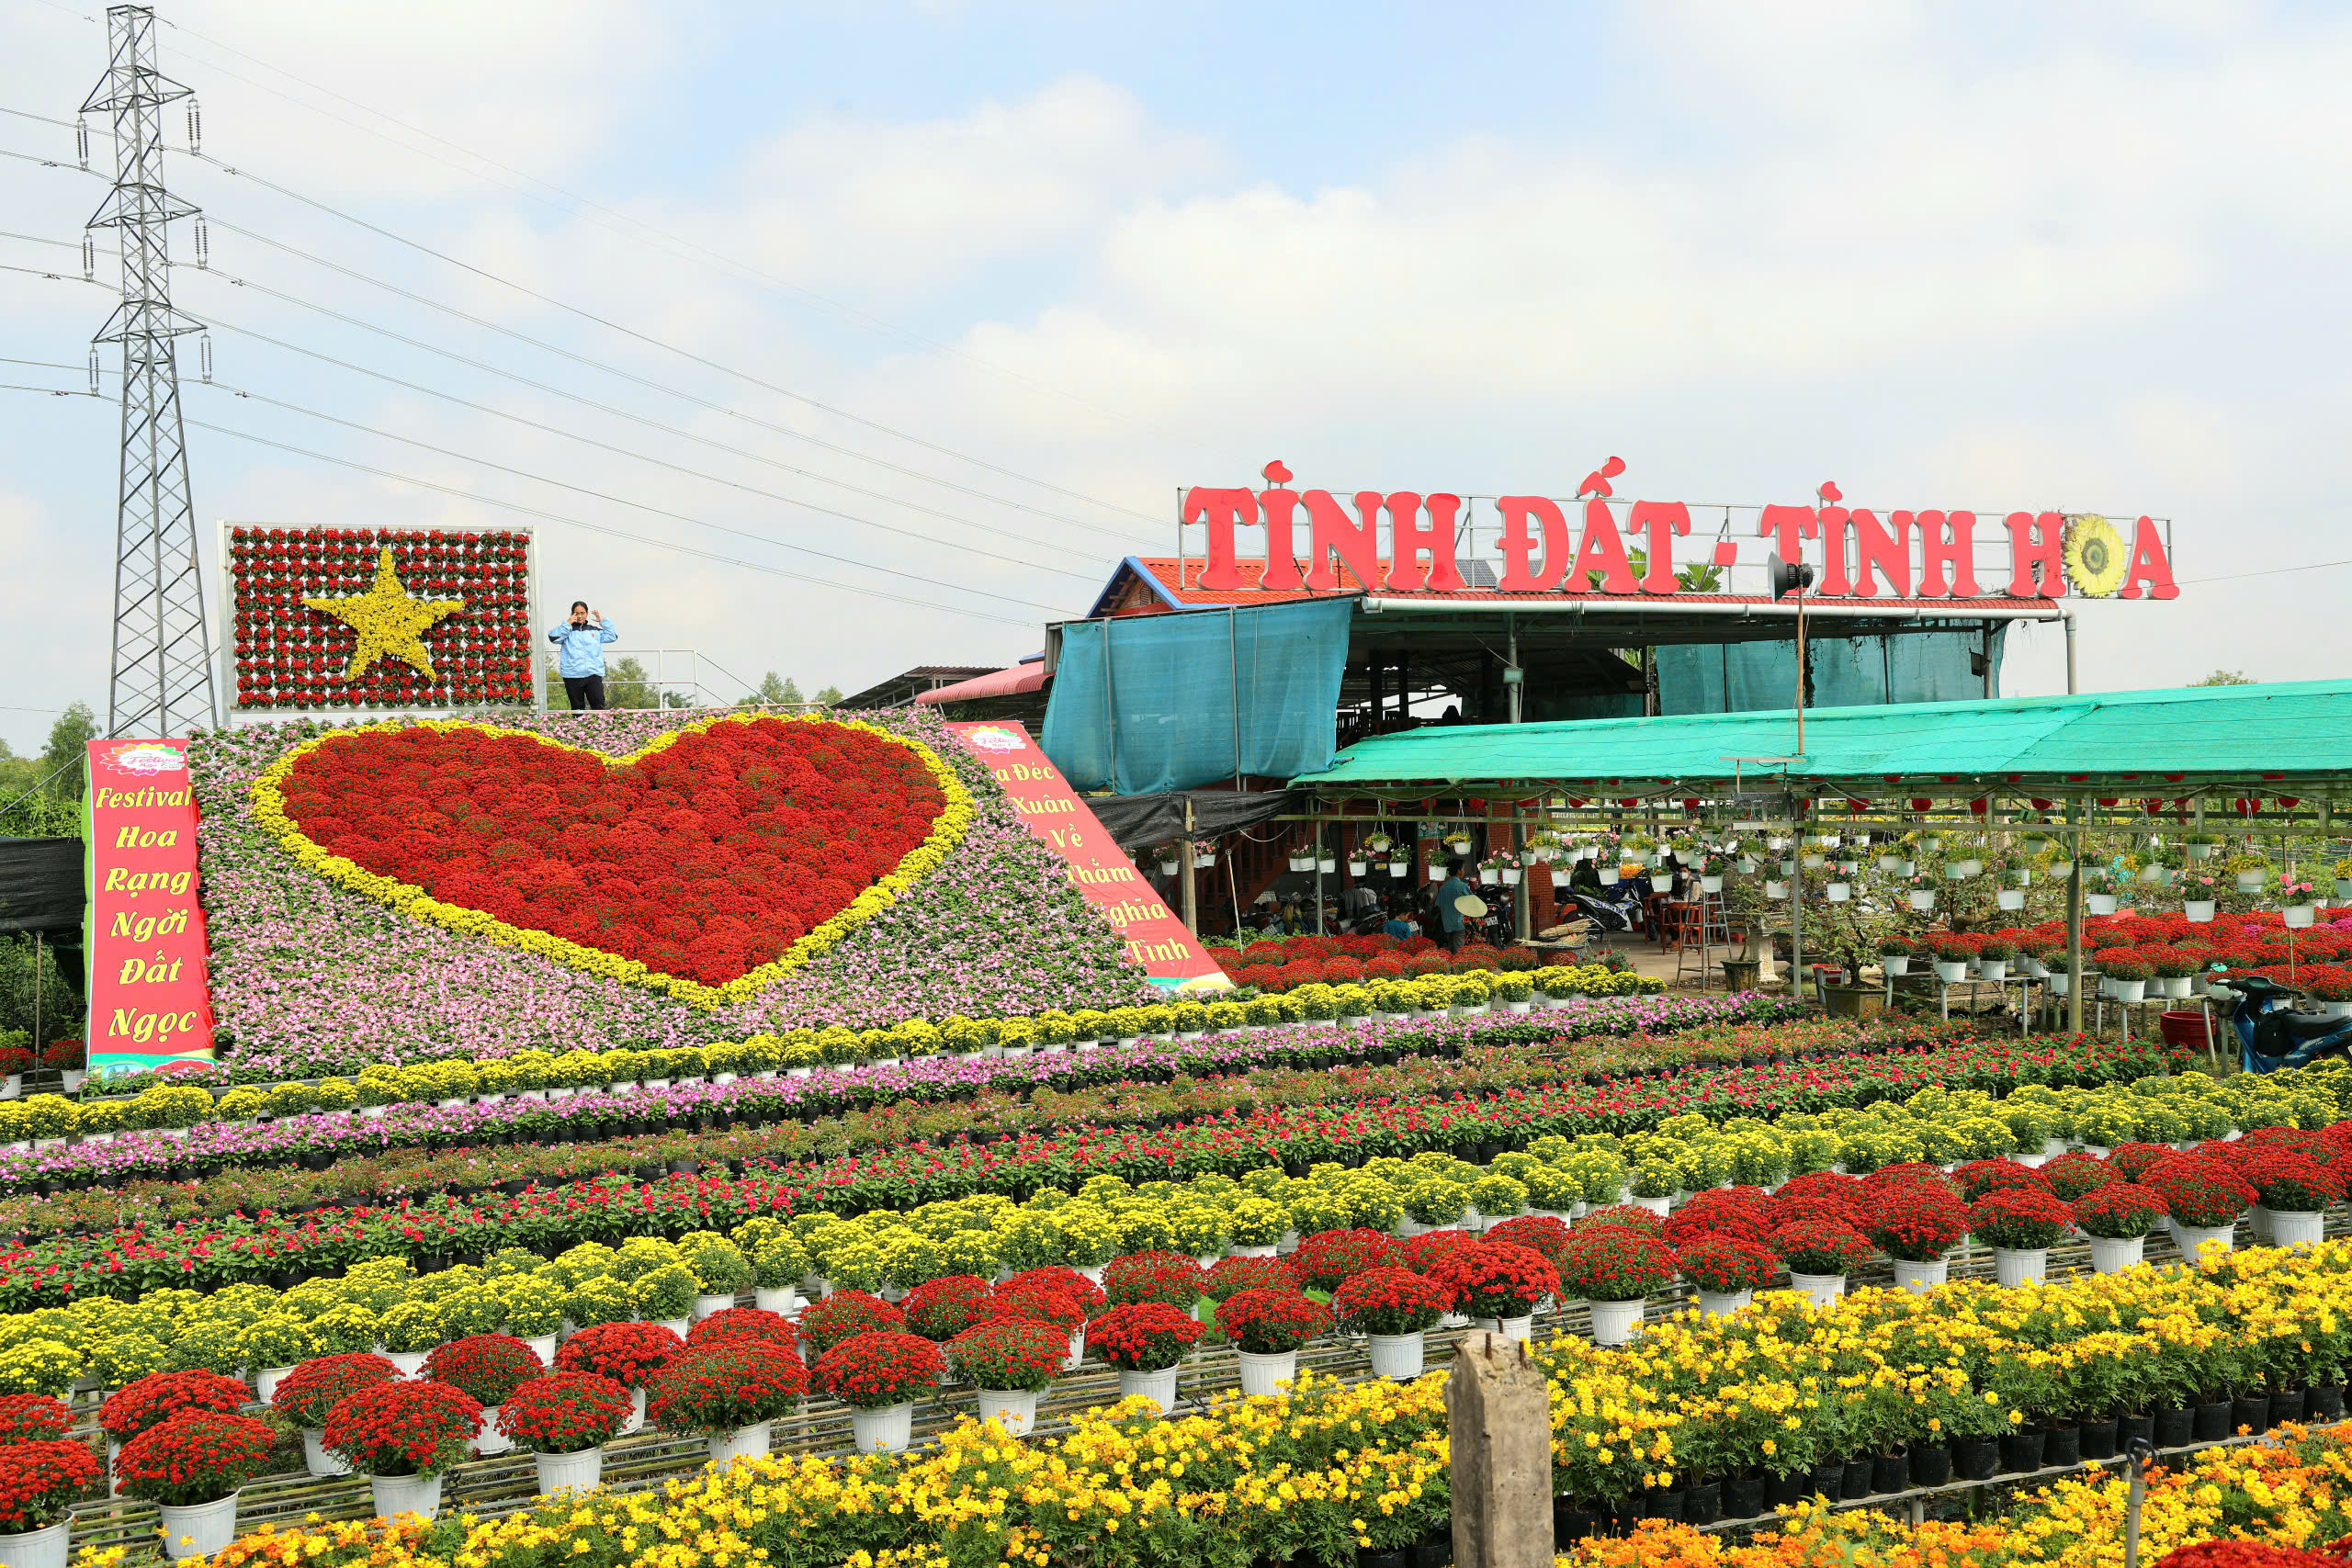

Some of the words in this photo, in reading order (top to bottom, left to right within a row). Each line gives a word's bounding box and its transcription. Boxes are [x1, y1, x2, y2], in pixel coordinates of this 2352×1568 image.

[96, 785, 194, 808] Festival
[1010, 794, 1076, 815] Xuân
[115, 826, 178, 848] Hoa
[1048, 822, 1083, 848] Về
[104, 867, 192, 898] Rạng
[109, 907, 189, 943] Ngời
[1125, 937, 1192, 964] Tình
[119, 949, 184, 985] Đất
[107, 1007, 198, 1043] Ngọc
